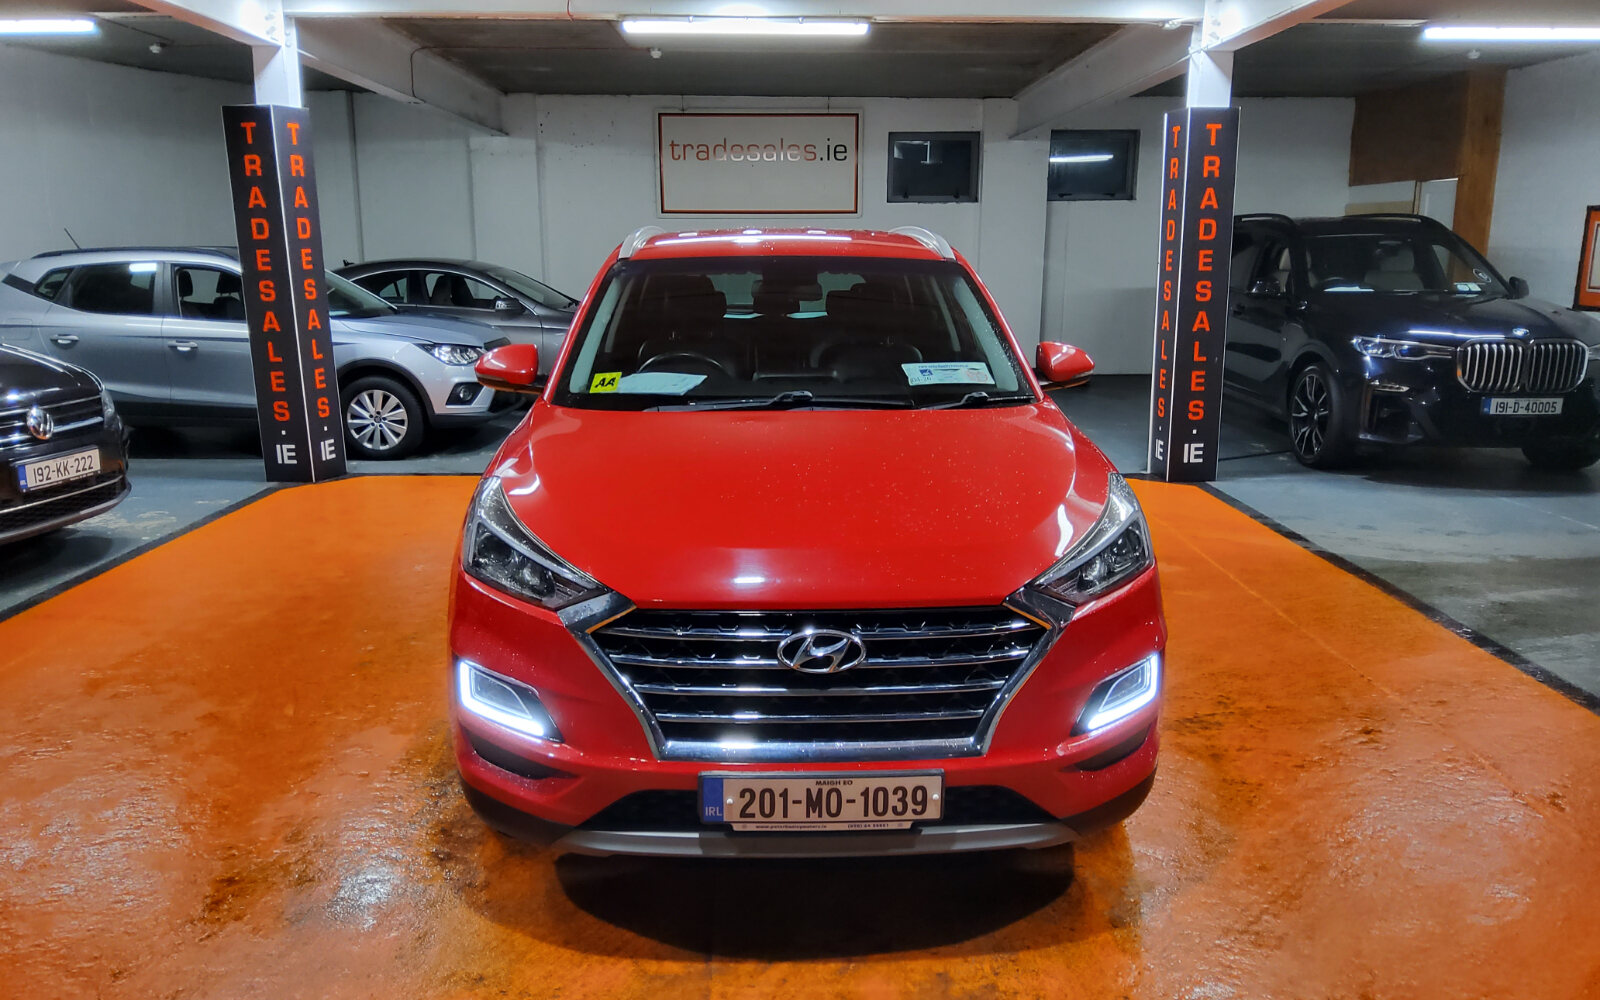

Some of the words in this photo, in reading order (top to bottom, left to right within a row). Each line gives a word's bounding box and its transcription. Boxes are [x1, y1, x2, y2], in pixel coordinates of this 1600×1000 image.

[669, 137, 848, 162] tradesales.ie
[594, 376, 617, 388] AA
[1495, 401, 1558, 413] 191-D-40005
[32, 455, 94, 484] 192-KK-222
[739, 785, 928, 819] 201-MO-1039
[705, 806, 723, 817] IRL
